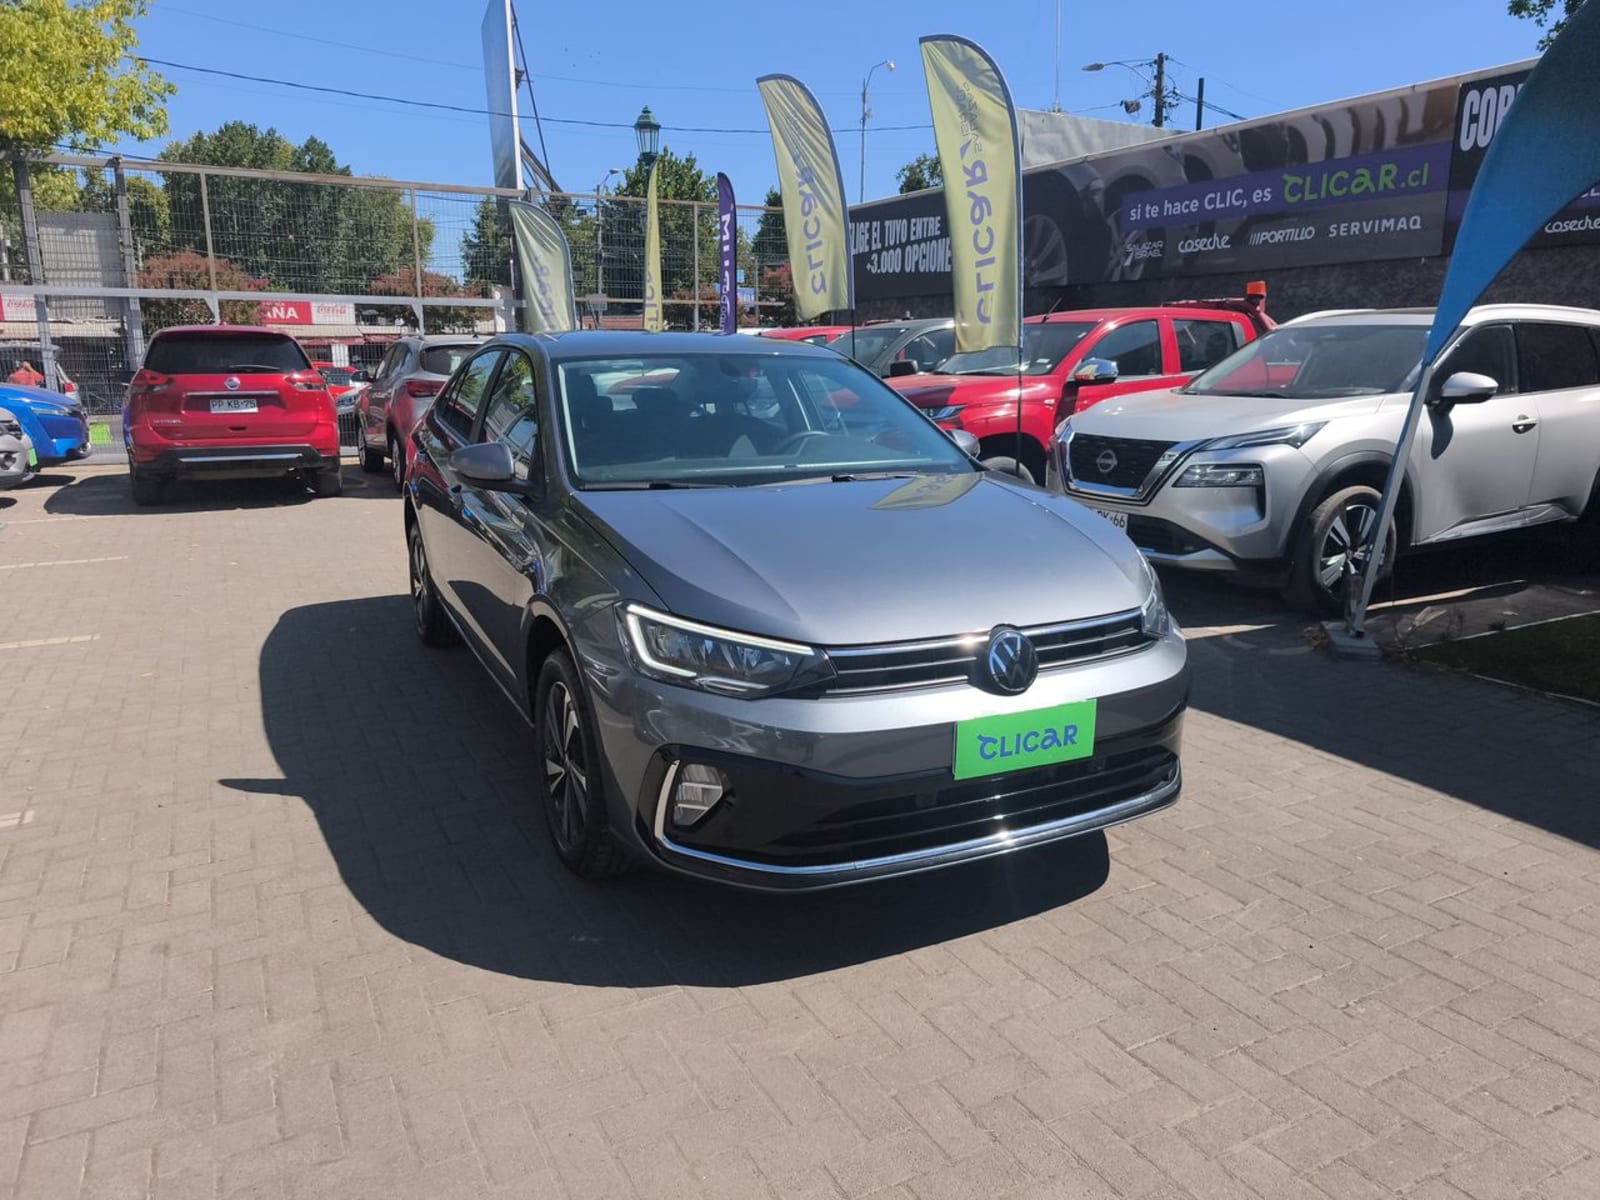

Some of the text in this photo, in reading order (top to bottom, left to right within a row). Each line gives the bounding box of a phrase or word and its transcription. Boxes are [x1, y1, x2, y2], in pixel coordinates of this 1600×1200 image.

[1459, 84, 1525, 152] CO
[1129, 187, 1273, 221] si te hace CLIC, es
[849, 215, 941, 255] LIGE EL TUYO ENTRE
[1328, 215, 1422, 237] SERVIMAQ
[1544, 215, 1600, 234] coseche
[1177, 233, 1231, 253] coseche
[866, 252, 902, 274] +3.000
[976, 724, 1079, 760] CLICAR
